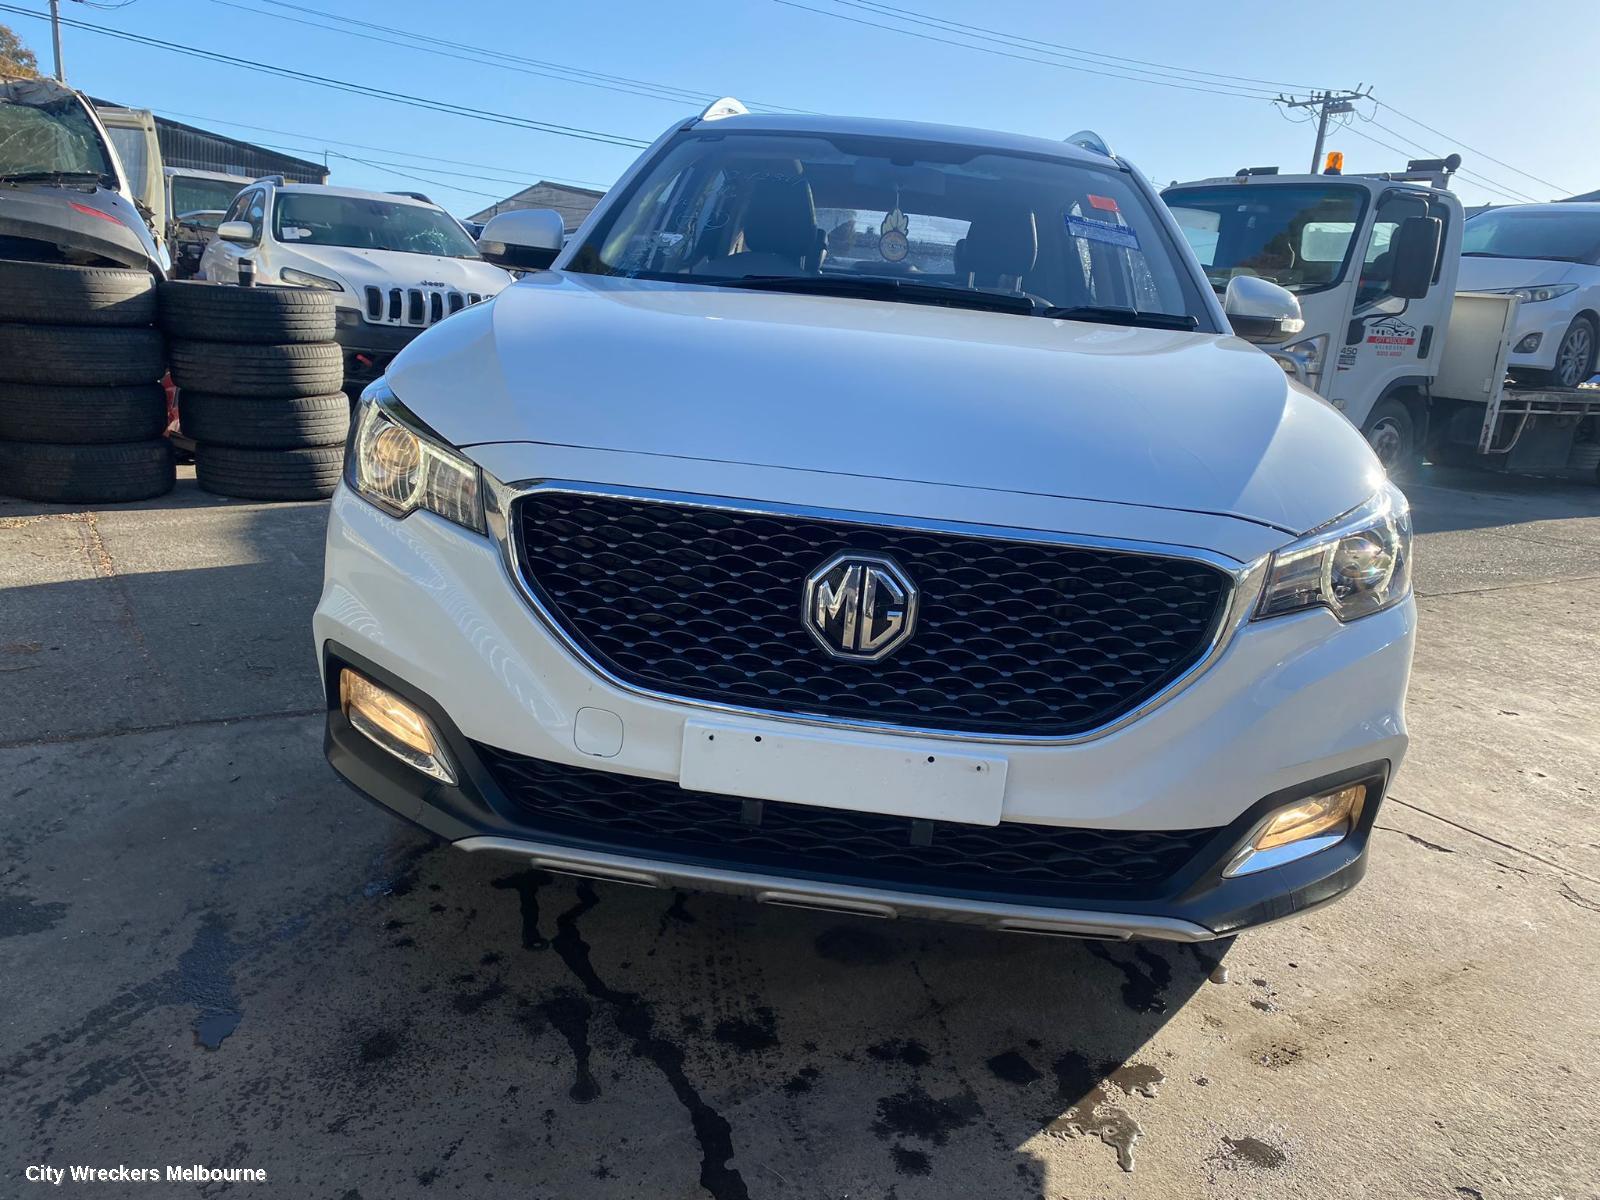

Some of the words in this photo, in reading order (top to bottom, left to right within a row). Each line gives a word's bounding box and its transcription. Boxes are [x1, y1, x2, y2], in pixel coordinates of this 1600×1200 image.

[421, 280, 445, 288] Jeep
[1340, 347, 1358, 355] 450
[816, 565, 904, 651] MG
